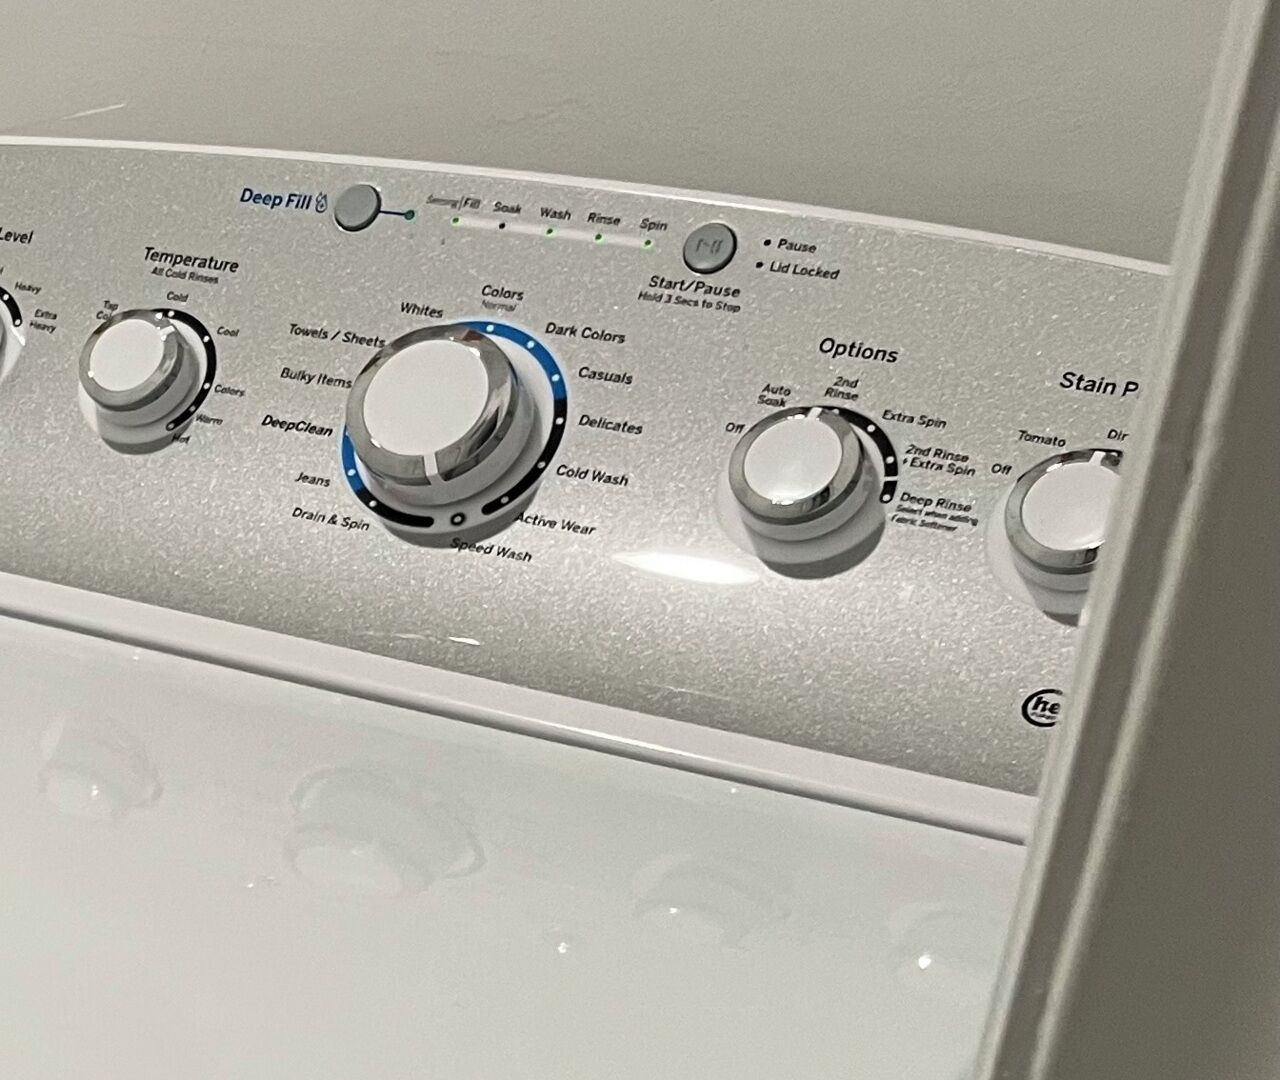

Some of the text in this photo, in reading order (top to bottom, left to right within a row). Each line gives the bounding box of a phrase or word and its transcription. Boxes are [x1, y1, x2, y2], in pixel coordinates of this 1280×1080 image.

[240, 187, 313, 211] Deep Fill
[493, 201, 522, 215] Soak
[540, 206, 572, 221] Wash
[586, 212, 621, 227] Rinse
[640, 218, 668, 233] Spin
[777, 238, 817, 254] Pause
[144, 246, 240, 273] Temperature
[151, 266, 219, 284] All Cold Rinses
[769, 260, 840, 280] Lid Locked
[15, 281, 42, 295] Heavy
[481, 284, 524, 301] Colors
[648, 275, 741, 298] Start/Pause
[103, 300, 119, 312] Tap
[166, 291, 189, 303] Cold
[481, 300, 518, 312] Normal
[638, 291, 741, 314] Hold 3 Secs to Stop
[34, 308, 58, 321] Extra
[400, 301, 444, 319] Whites
[30, 321, 57, 334] Heavy
[216, 326, 240, 337] Cool
[289, 323, 329, 339] Towels
[341, 331, 386, 348] Sheets
[545, 322, 626, 344] Dark Colors
[819, 337, 899, 364] Options
[280, 366, 353, 389] Bulky Items
[578, 366, 633, 385] Casuals
[833, 376, 859, 389] 2nd
[1059, 371, 1117, 396] Stain
[214, 384, 246, 397] Colors
[762, 383, 791, 397] Auto
[824, 386, 860, 402] Rinse
[757, 395, 786, 408] Soak
[196, 413, 224, 426] Warm
[261, 414, 334, 437] DeepClean
[578, 414, 644, 435] Delicates
[882, 409, 947, 429] Extra Spin
[725, 422, 746, 435] Off
[171, 434, 191, 444] Hot
[1017, 429, 1066, 448] Tomato
[905, 443, 970, 463] 2nd Rinse
[556, 464, 629, 487] Cold Wash
[909, 456, 944, 471] Extra
[946, 462, 976, 477] Spin
[991, 463, 1013, 476] Off
[294, 472, 331, 488] Jeans
[899, 491, 973, 512] Deep Rinse
[292, 507, 370, 532] Drain & Spin
[516, 511, 597, 535] Active Wear
[449, 537, 533, 563] Speed Wash
